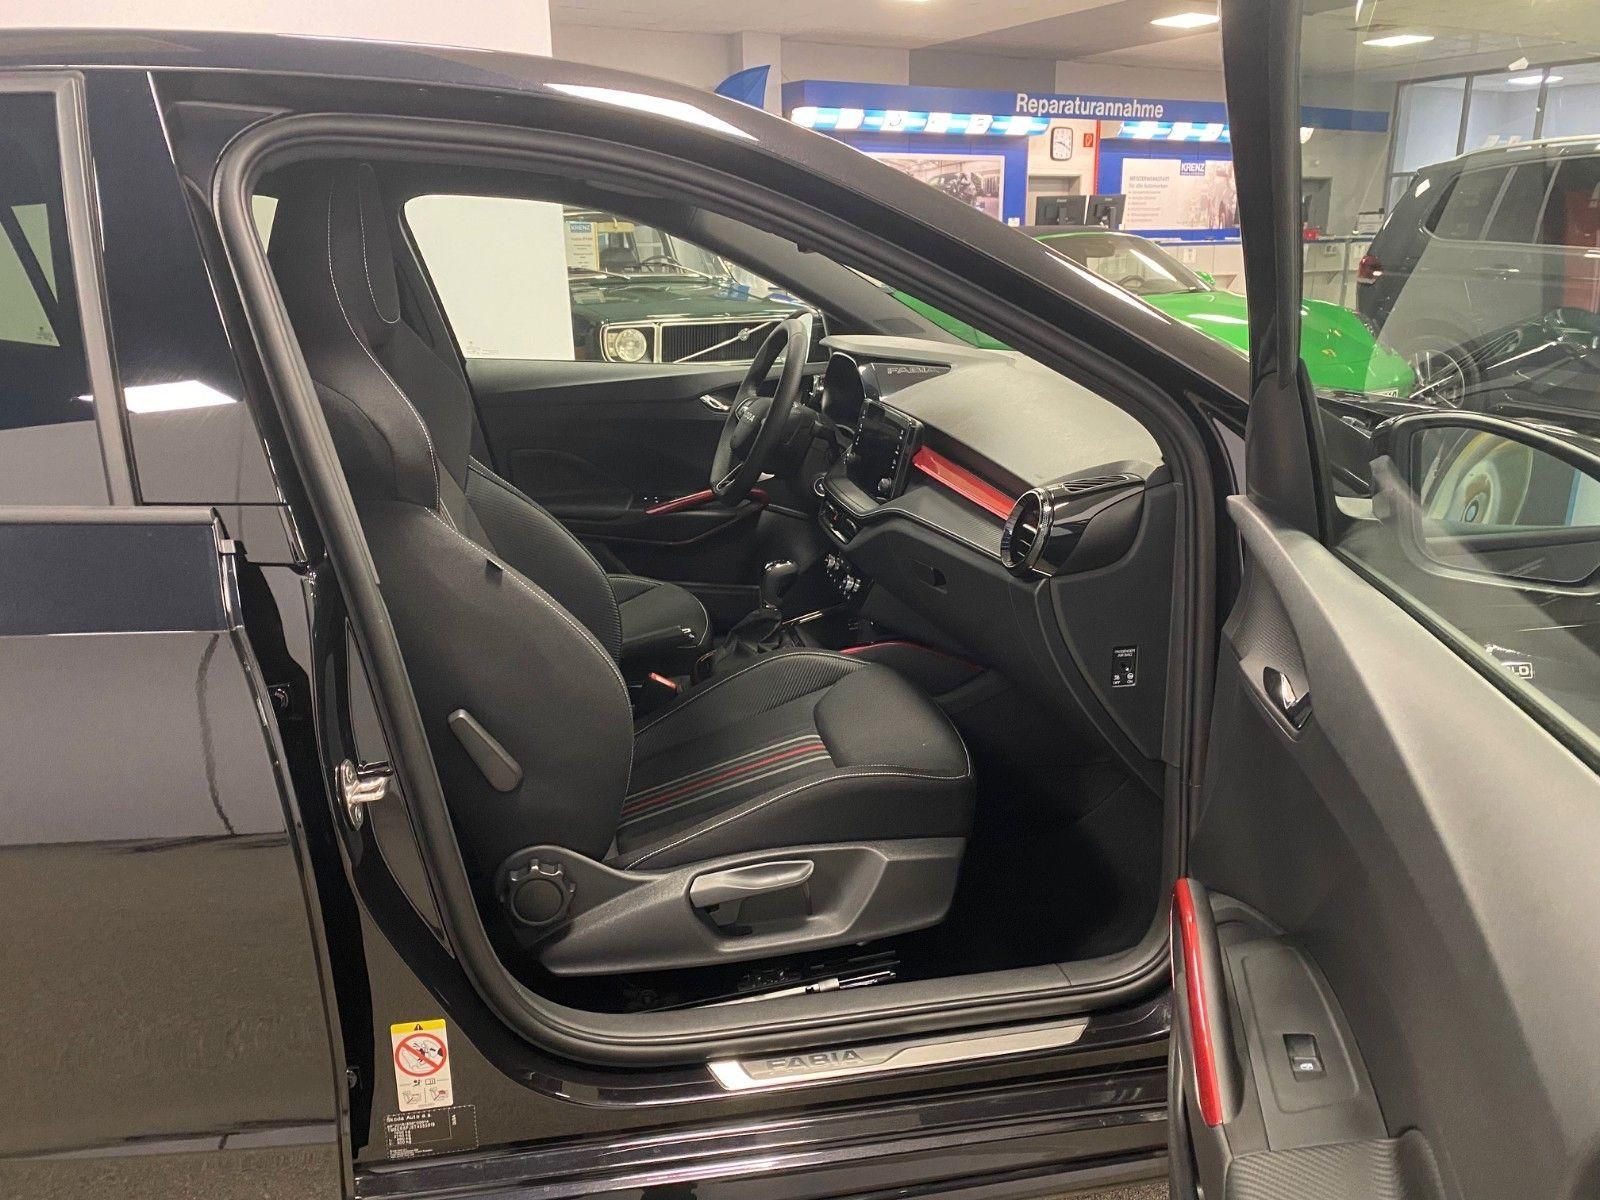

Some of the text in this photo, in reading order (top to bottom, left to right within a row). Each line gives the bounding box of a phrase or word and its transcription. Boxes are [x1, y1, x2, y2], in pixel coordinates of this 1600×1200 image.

[1016, 93, 1164, 119] Reparaturannahme
[1181, 162, 1205, 172] KRENZ
[766, 1049, 864, 1069] FABIA
